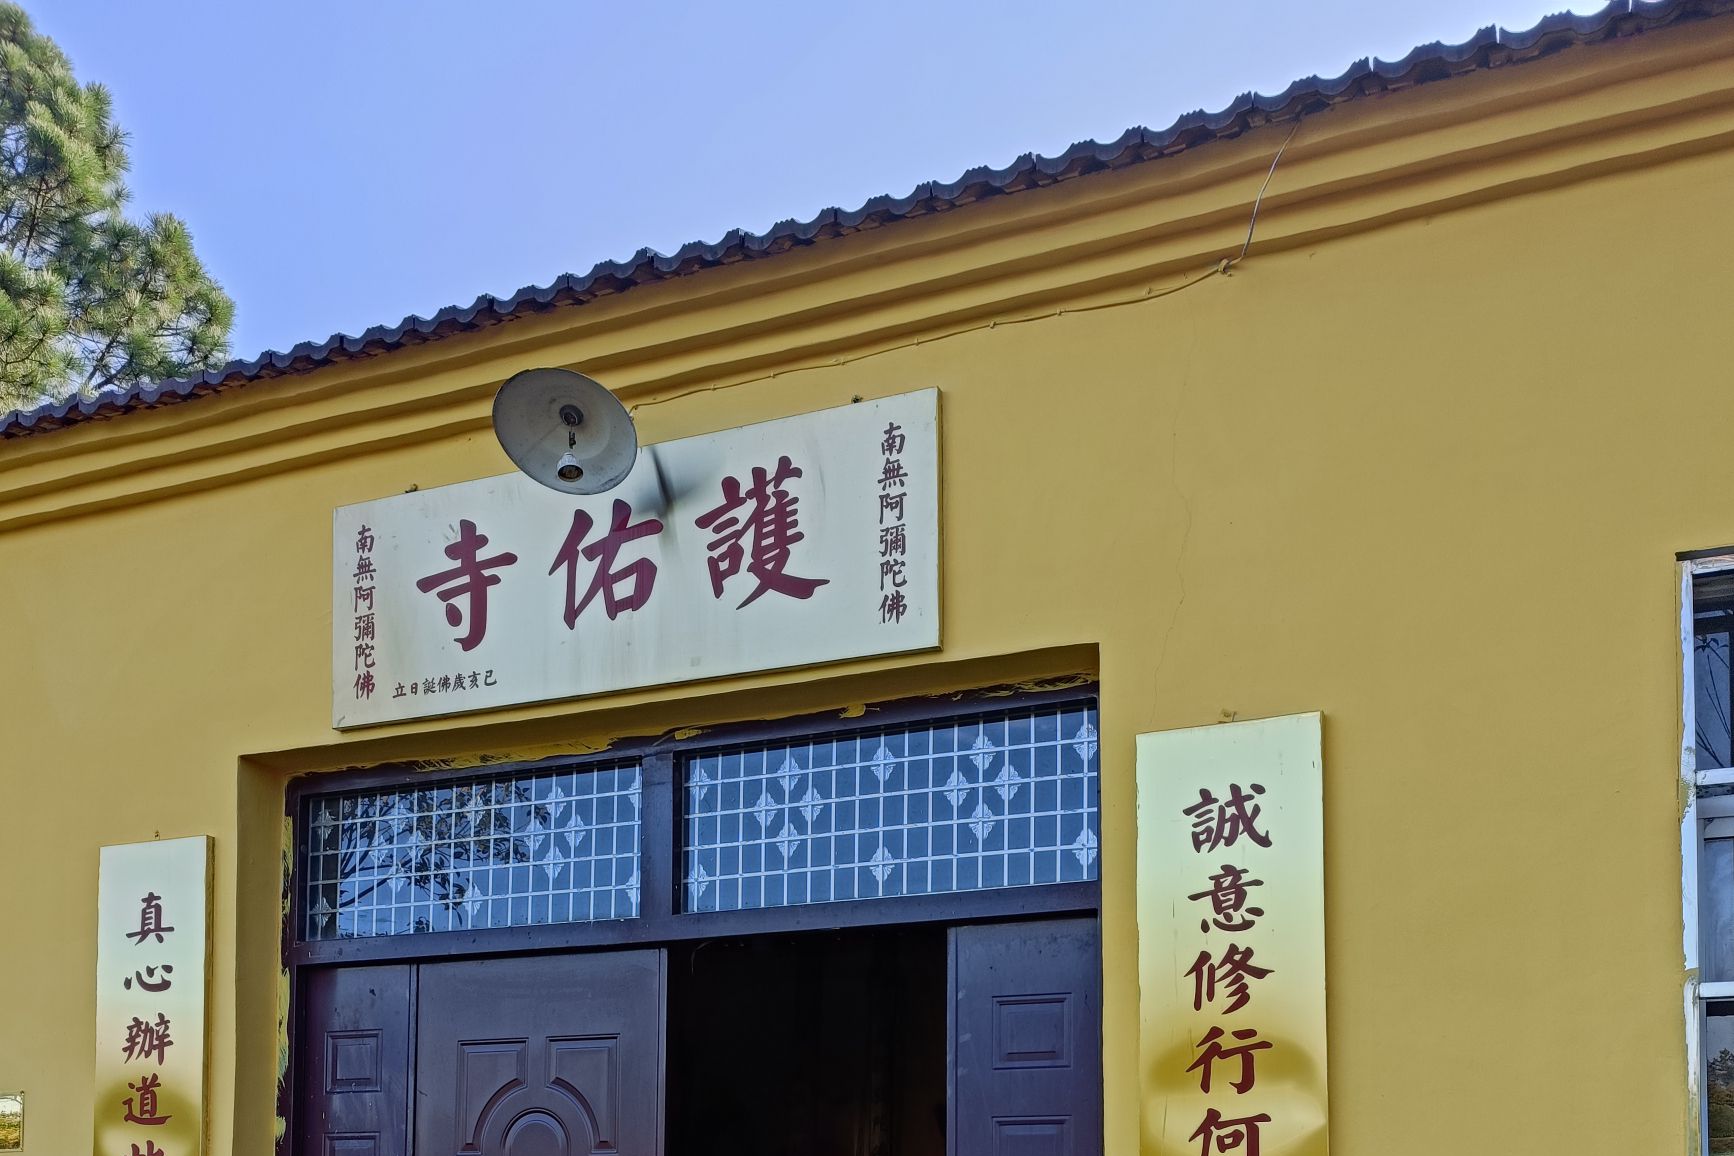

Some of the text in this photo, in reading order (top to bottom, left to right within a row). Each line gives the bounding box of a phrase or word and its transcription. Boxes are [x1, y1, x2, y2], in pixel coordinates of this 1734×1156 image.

[352, 524, 377, 700] 南無阿彌陀佛
[877, 421, 908, 625] 南無阿彌陀佛
